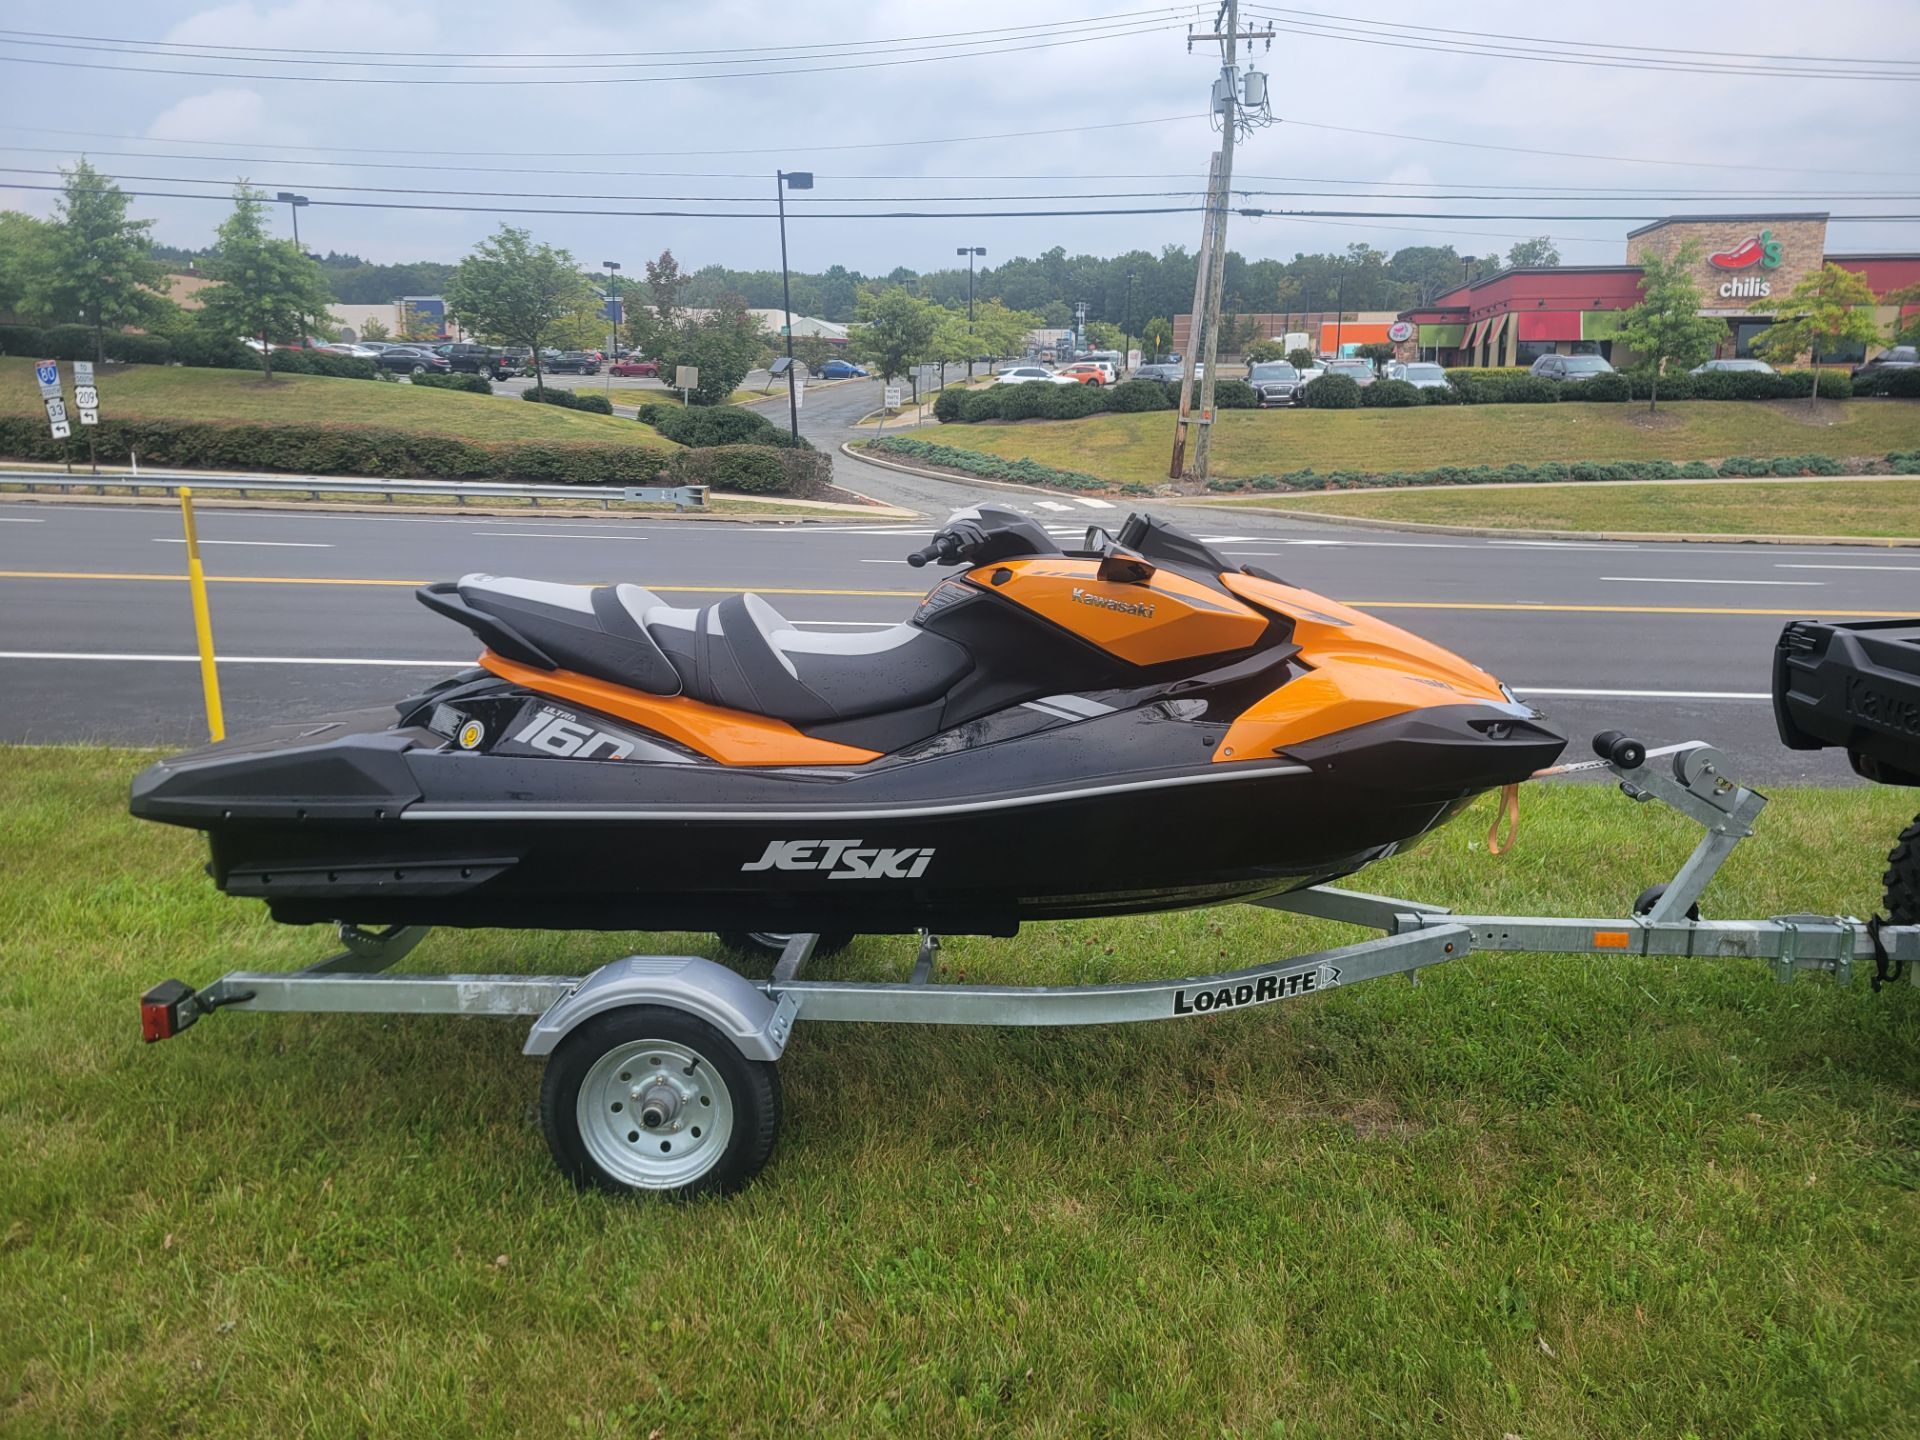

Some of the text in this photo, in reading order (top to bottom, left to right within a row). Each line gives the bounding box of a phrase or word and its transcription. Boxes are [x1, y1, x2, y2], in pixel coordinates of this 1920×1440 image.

[40, 367, 55, 382] 80
[78, 391, 95, 404] 209
[49, 404, 64, 417] 33
[1071, 587, 1156, 618] Kawasaki
[542, 705, 577, 722] ULTRA
